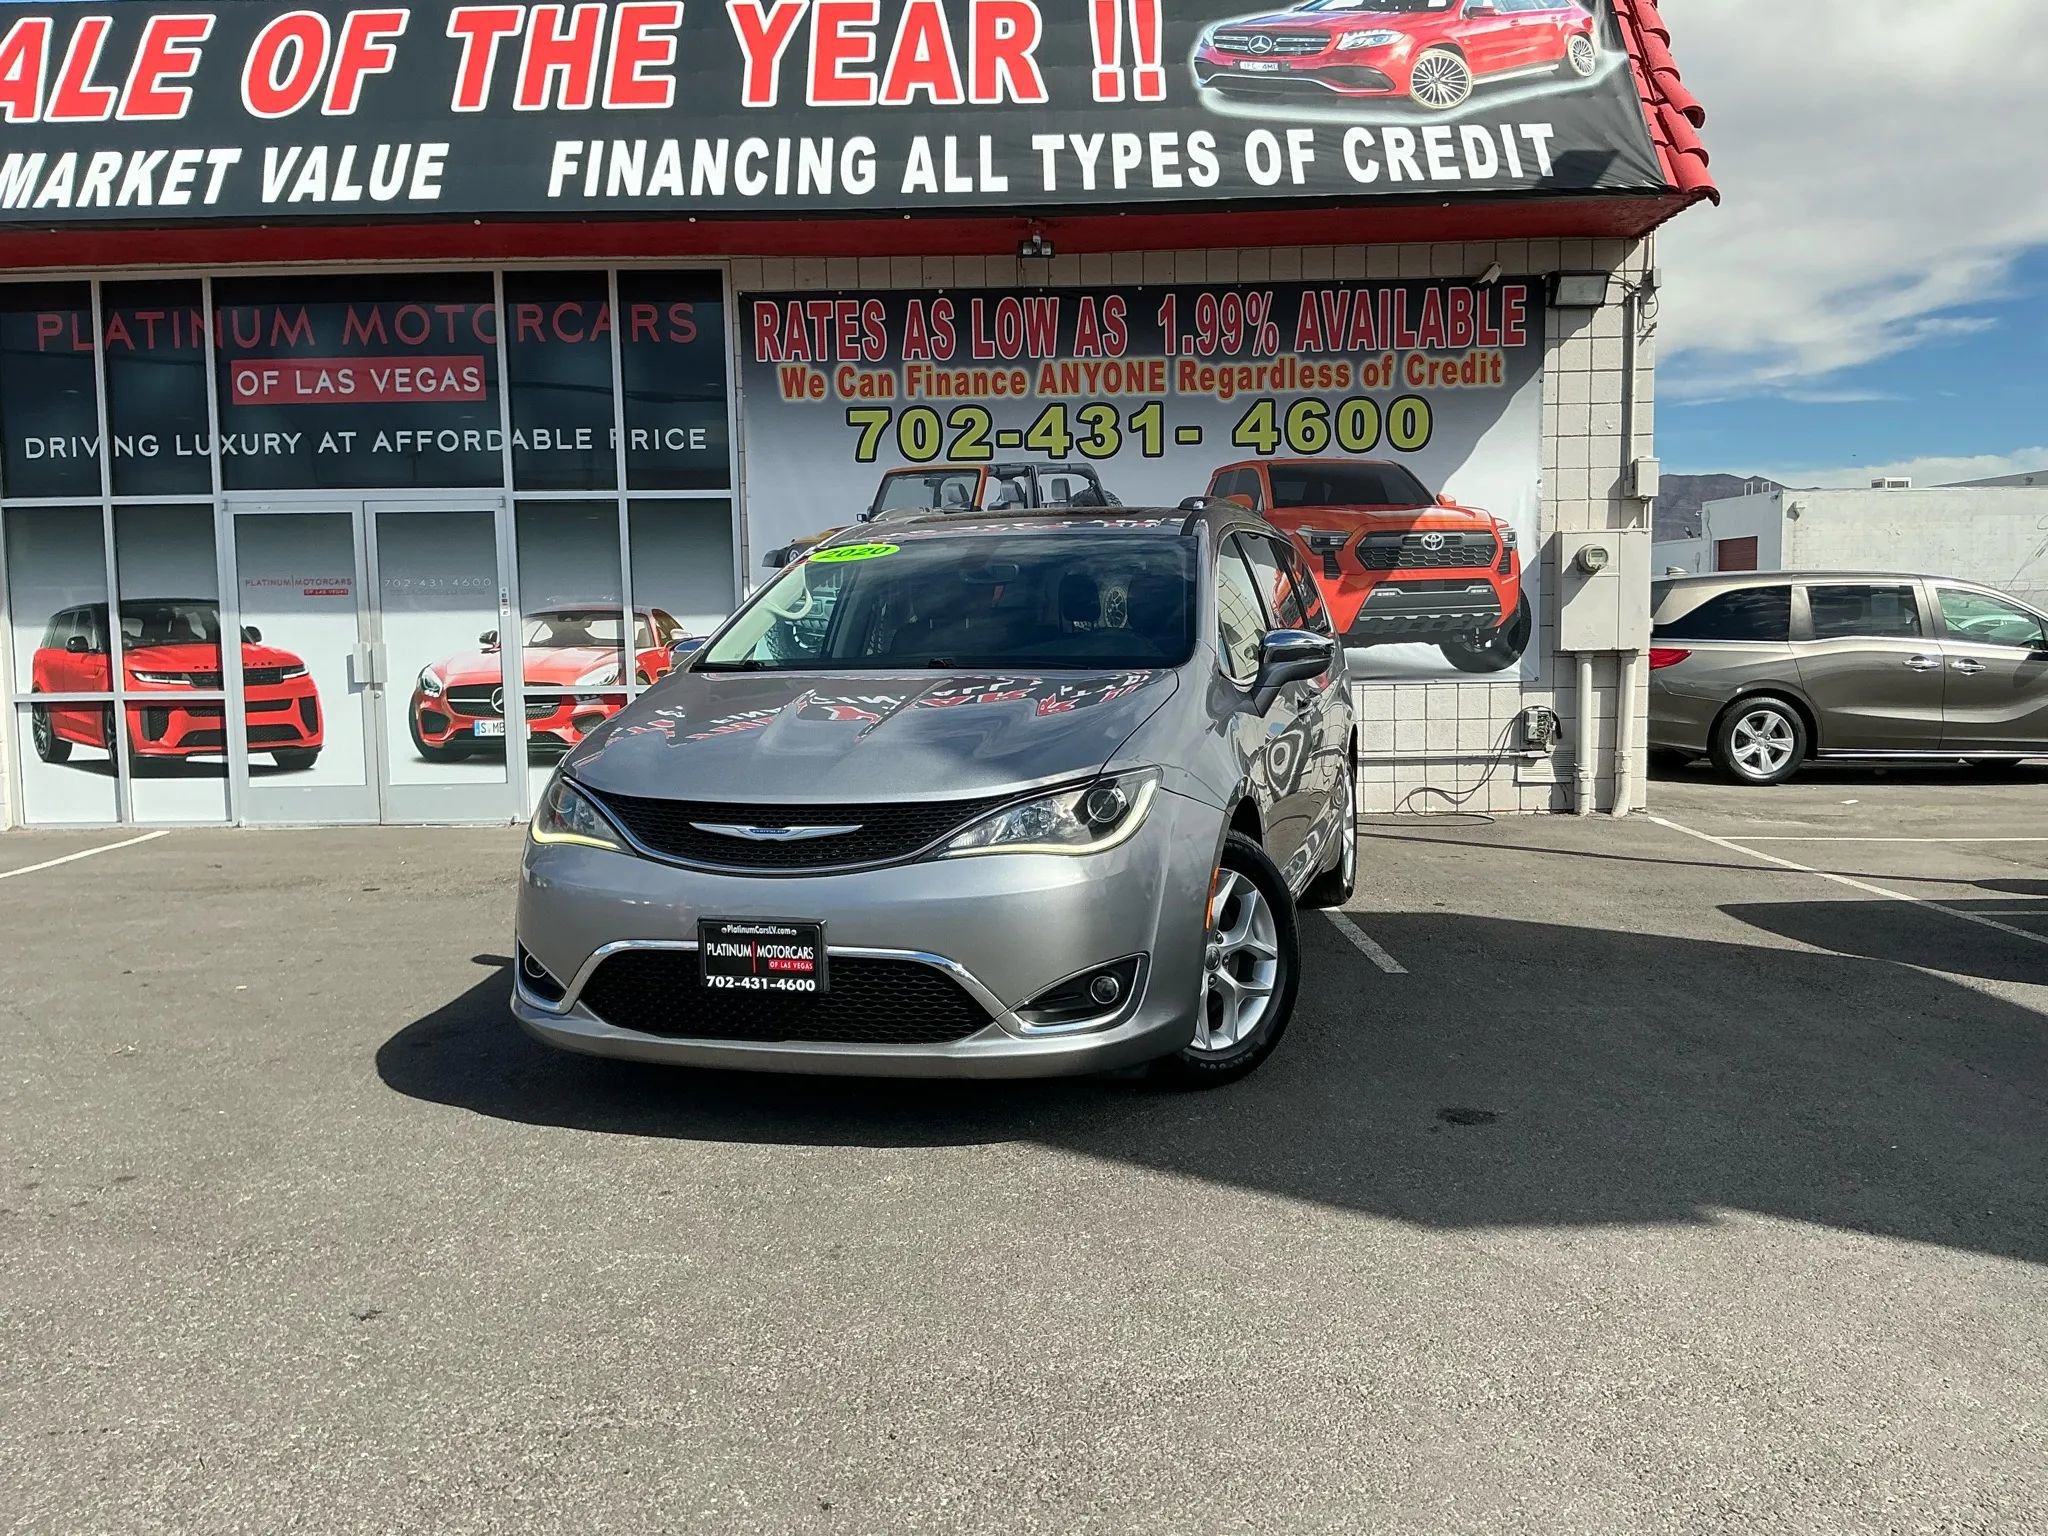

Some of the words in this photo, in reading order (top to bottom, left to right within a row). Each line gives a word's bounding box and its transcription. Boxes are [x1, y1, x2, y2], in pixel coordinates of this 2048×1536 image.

[241, 9, 411, 119] OF
[446, 1, 684, 111] THE
[726, 0, 1049, 107] YEAR
[1089, 0, 1167, 102] !!
[0, 148, 242, 209] MARKET
[260, 143, 450, 203] VALUE
[547, 137, 877, 197] FINANCING
[901, 135, 1009, 193] ALL
[1031, 131, 1219, 191] TYPES
[1244, 128, 1316, 187] OF
[1342, 122, 1555, 183] CREDIT
[36, 306, 315, 351] PLATINUM
[342, 303, 697, 346] MOTORCARS
[753, 299, 887, 362] RATES
[902, 297, 955, 360] AS
[971, 297, 1059, 359] LOW
[1073, 294, 1128, 358] AS
[1157, 291, 1280, 356] 1.99%
[1294, 285, 1528, 352] AVAILABLE
[236, 370, 280, 396] OF
[295, 368, 356, 394] LAS
[370, 366, 481, 393] VEGAS
[779, 363, 826, 398] We
[837, 361, 894, 398] Can
[905, 363, 1027, 397] Finance
[1038, 357, 1168, 396] ANYONE
[1177, 355, 1351, 402] Regardless
[1362, 352, 1395, 388] of
[1405, 350, 1504, 388] Credit
[1232, 395, 1434, 457] 4600
[25, 434, 160, 459] DRIVNG
[175, 432, 302, 456] LUXURY
[317, 431, 357, 453] AT
[371, 428, 593, 453] AFFORDABLE
[817, 547, 890, 559] 2020
[727, 924, 791, 936] PlatinumCarsLV.com
[706, 942, 752, 957] PLATINUM
[757, 944, 814, 960] MOTORCARS
[781, 961, 791, 969] LAS
[792, 962, 813, 970] VEGAS
[706, 975, 816, 992] 702-431-4600
